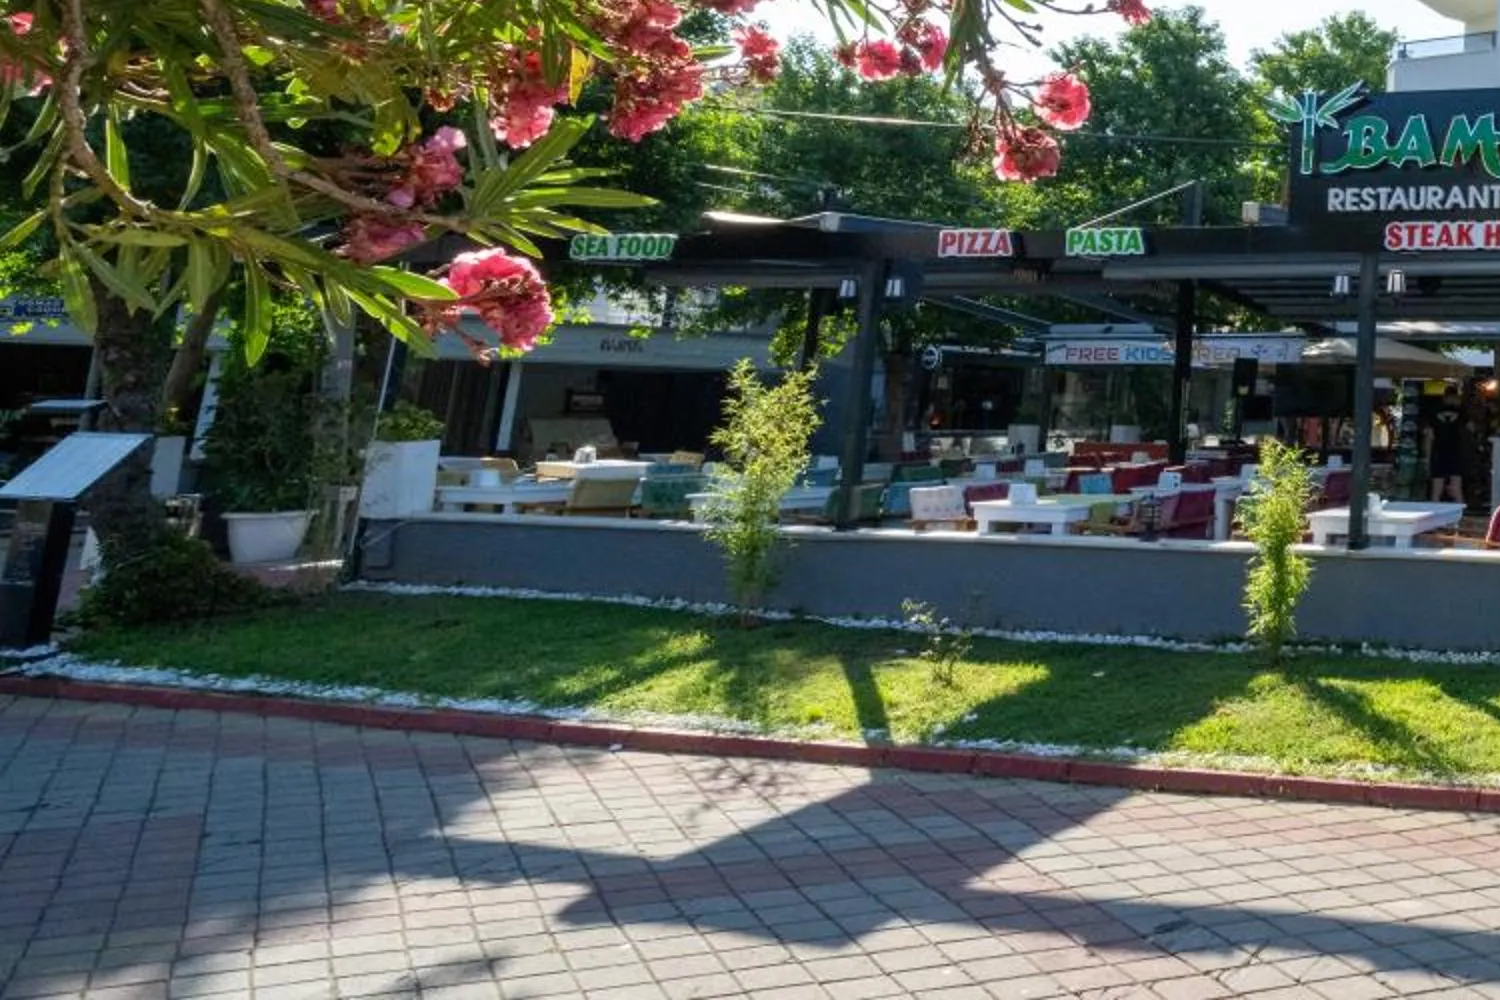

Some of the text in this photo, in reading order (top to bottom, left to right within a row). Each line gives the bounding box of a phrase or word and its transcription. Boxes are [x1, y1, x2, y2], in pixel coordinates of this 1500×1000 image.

[573, 233, 672, 257] SEA FOOD
[941, 230, 1012, 255] PIZZA
[1068, 229, 1143, 254] PASTA
[1386, 222, 1474, 248] STEAK
[1065, 346, 1119, 362] FREE
